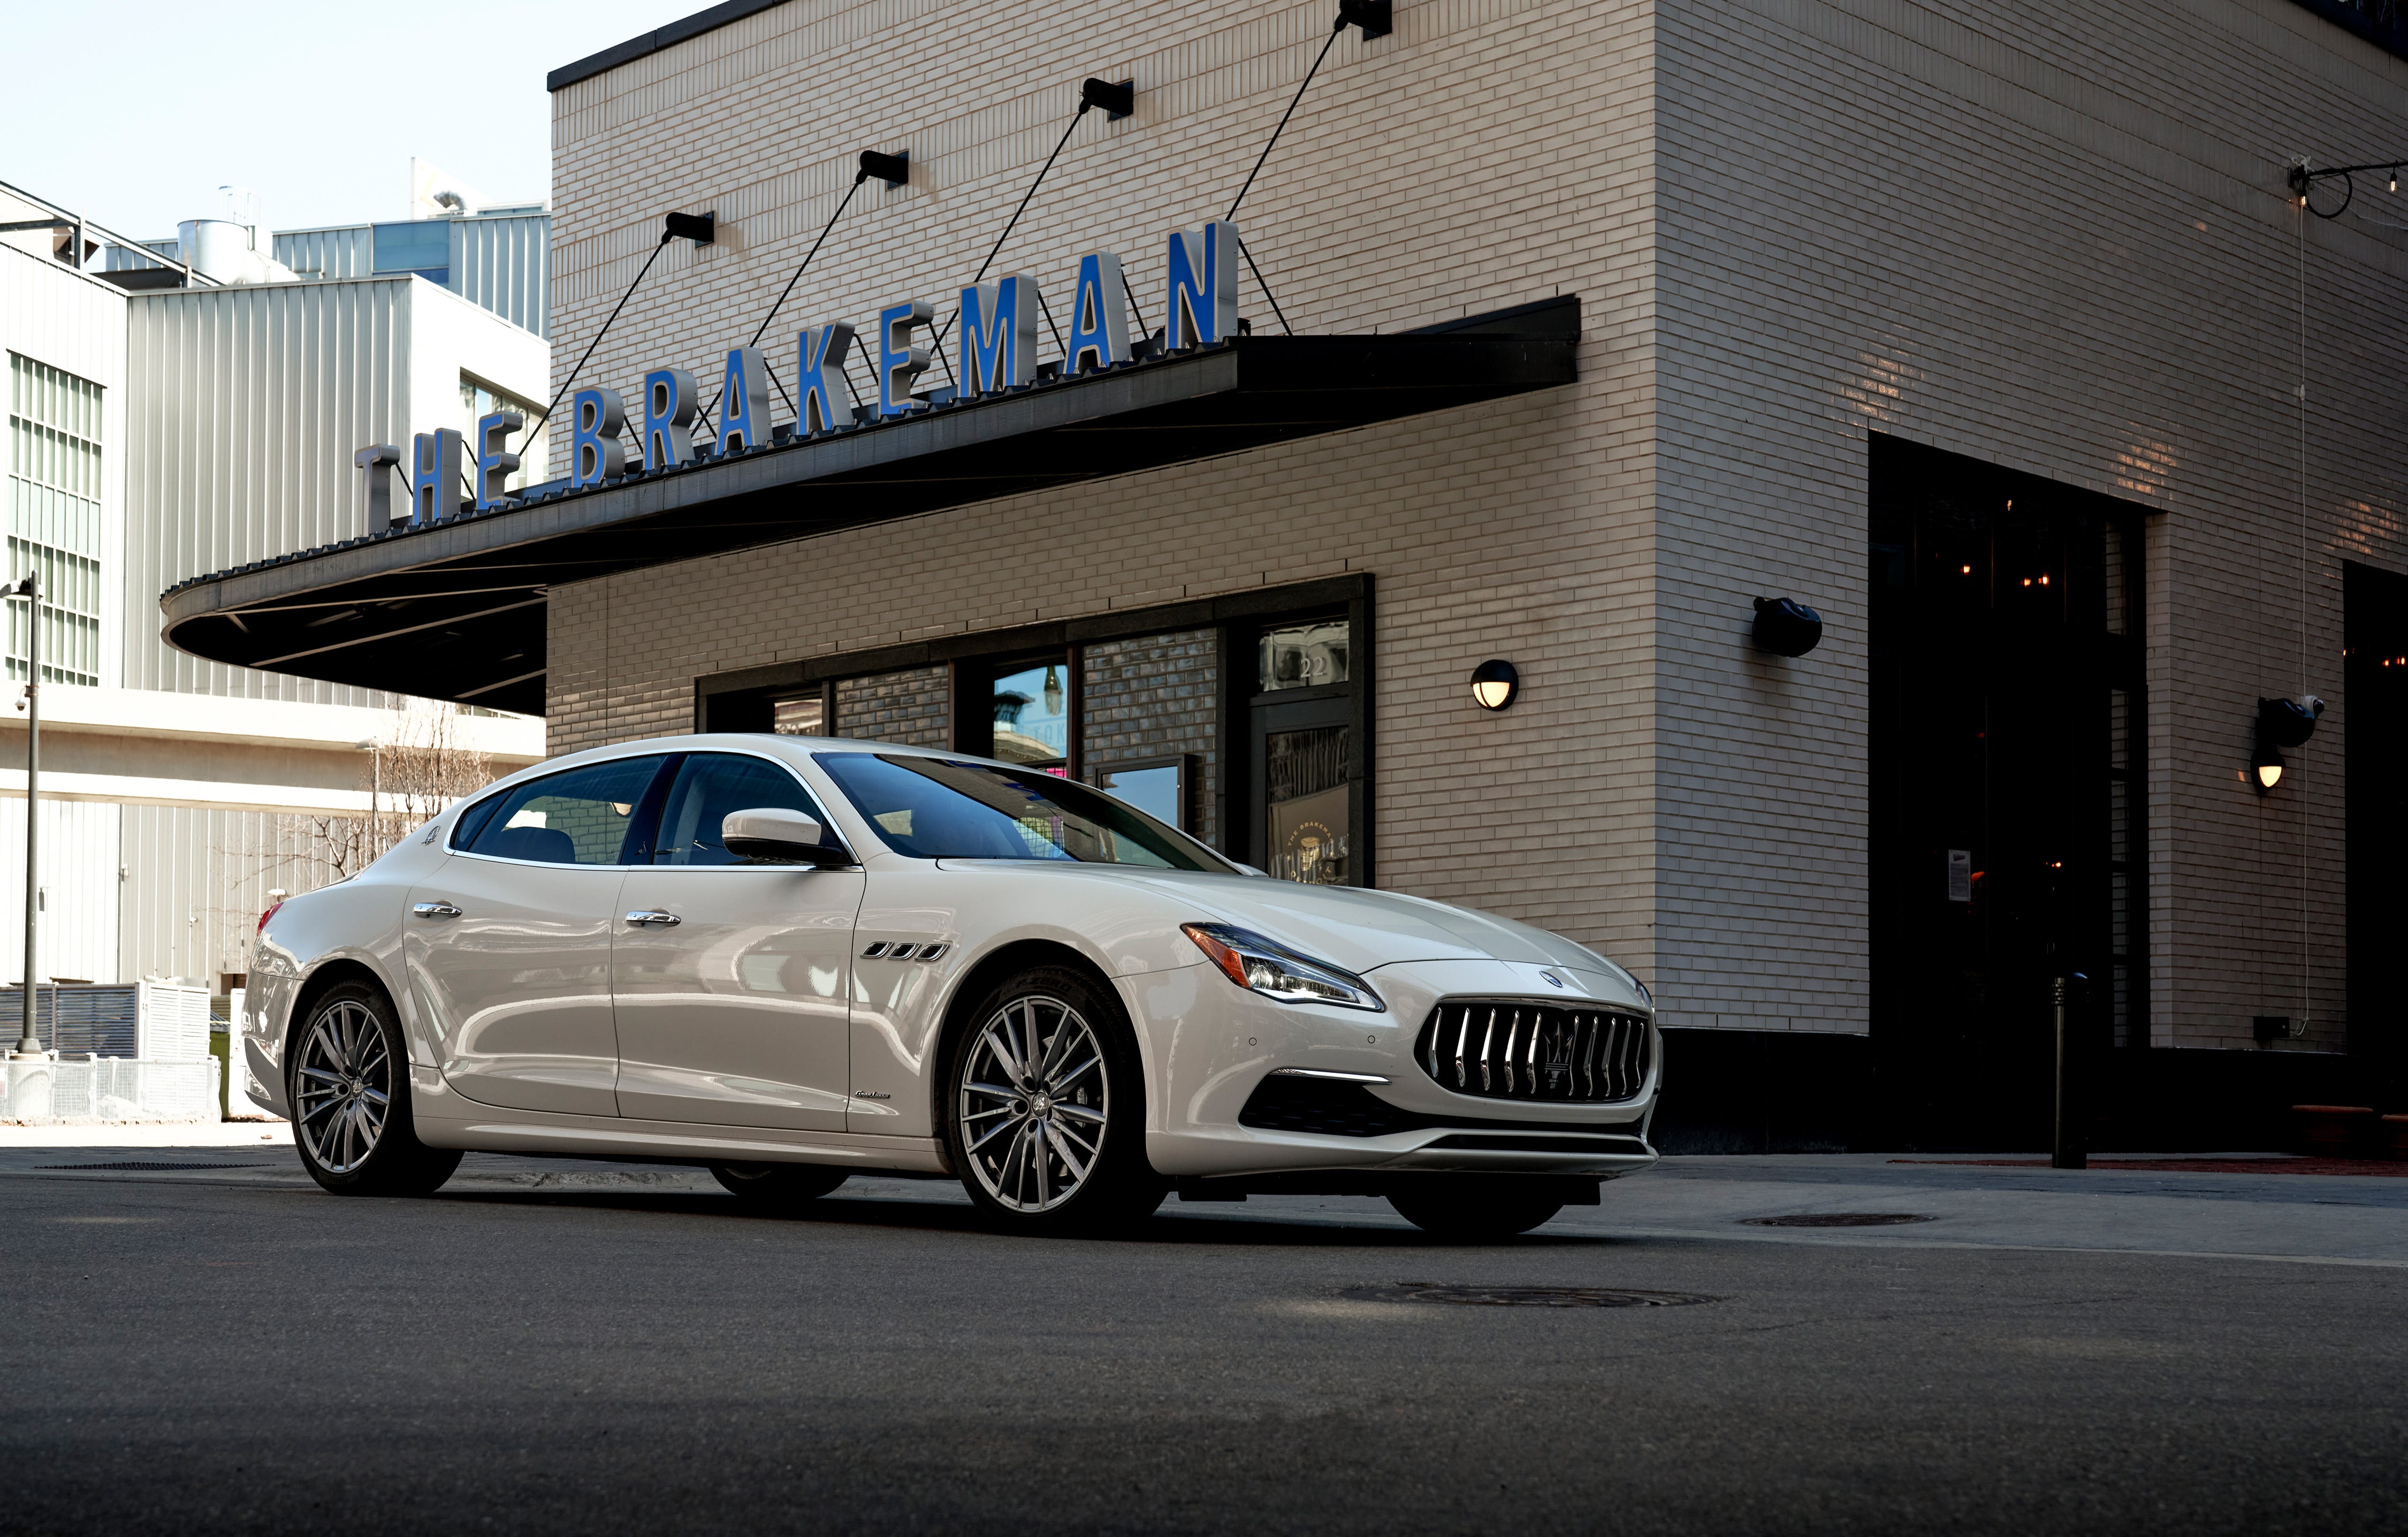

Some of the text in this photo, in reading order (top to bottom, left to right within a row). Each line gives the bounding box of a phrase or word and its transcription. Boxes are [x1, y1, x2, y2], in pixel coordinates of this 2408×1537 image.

[354, 218, 1239, 537] THE BRAKEMAN
[1300, 657, 1323, 678] 22
[1287, 821, 1335, 846] THE BRAKEMAN
